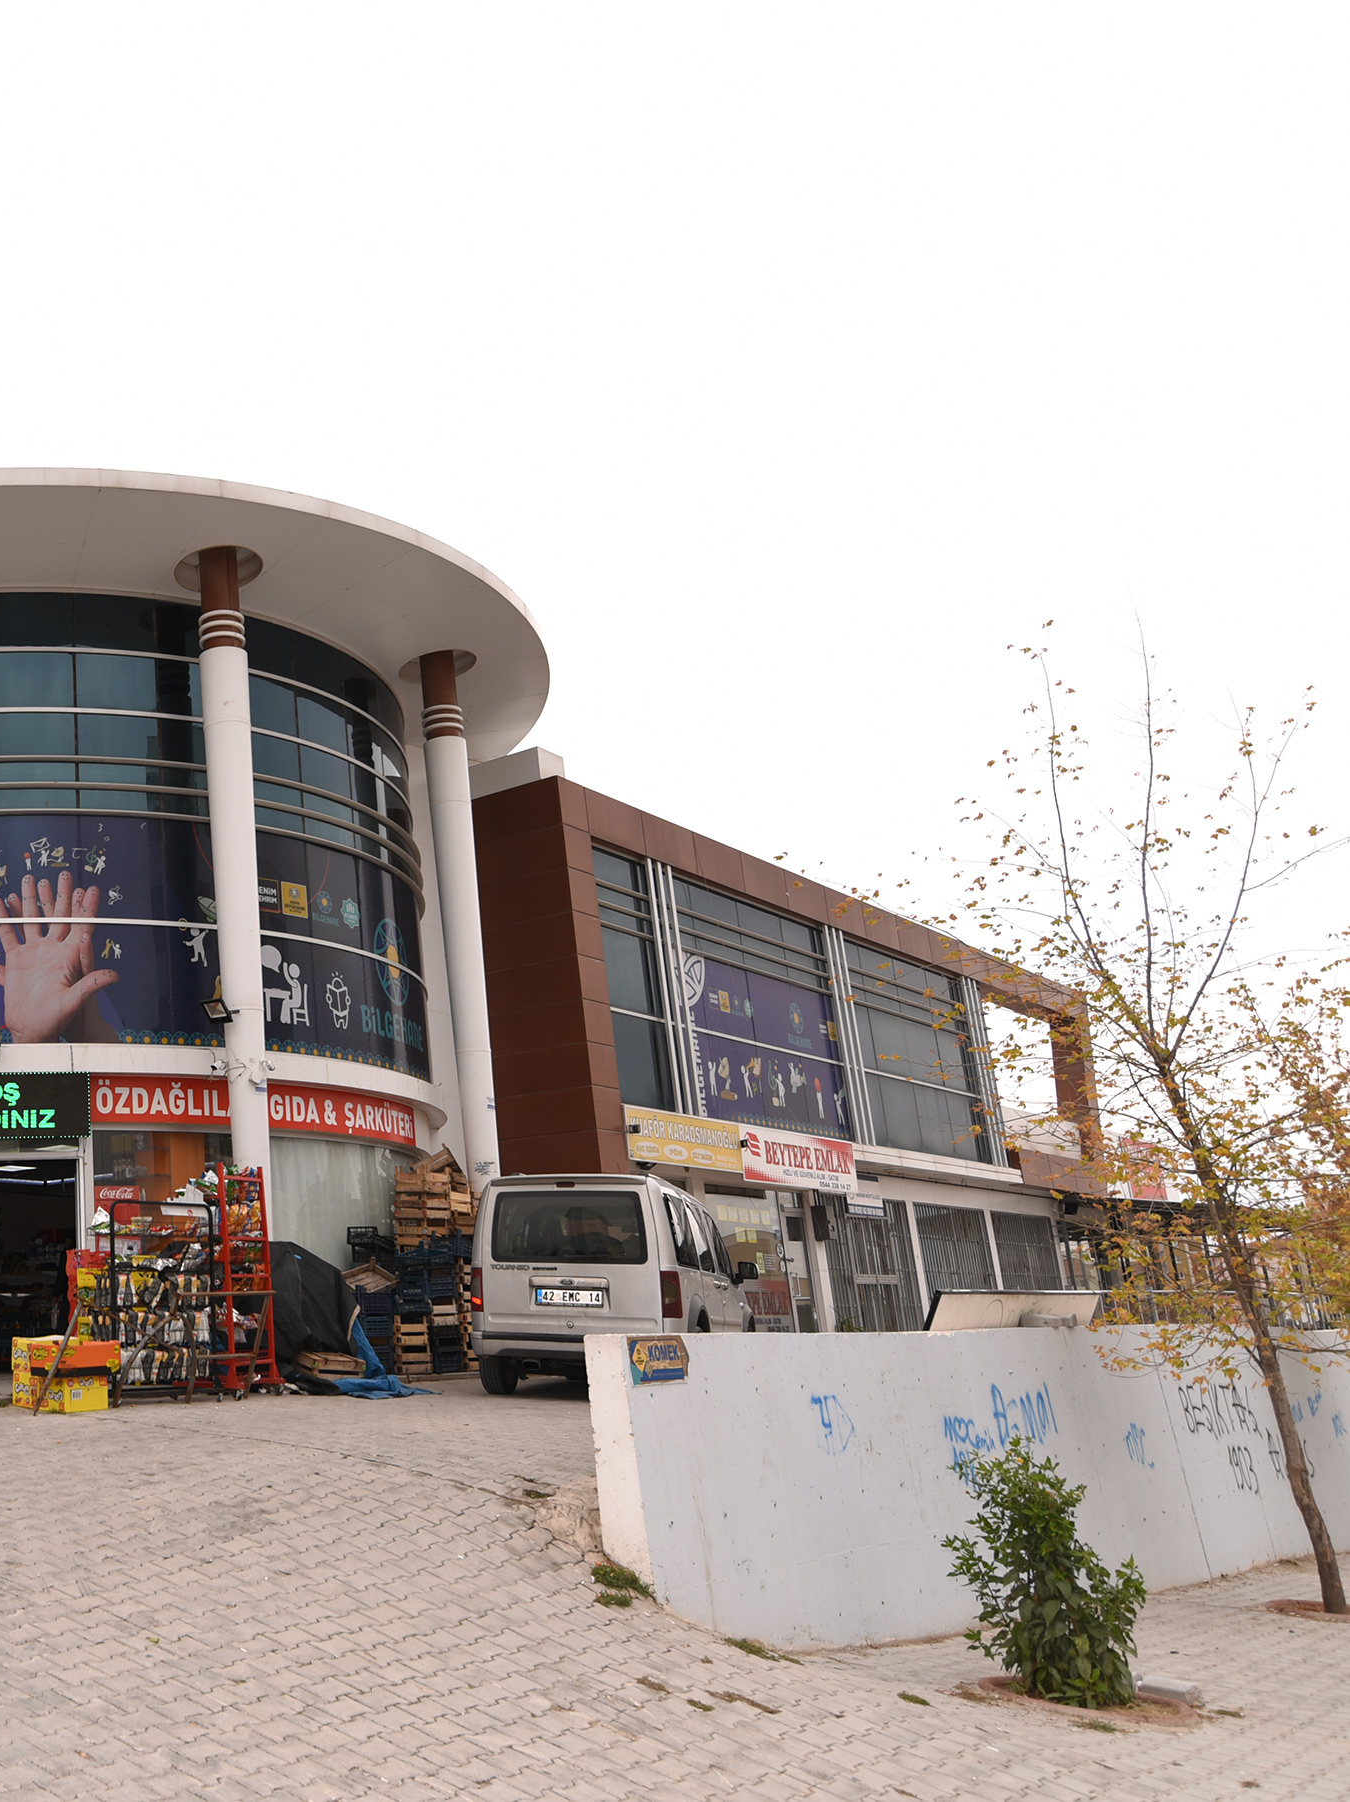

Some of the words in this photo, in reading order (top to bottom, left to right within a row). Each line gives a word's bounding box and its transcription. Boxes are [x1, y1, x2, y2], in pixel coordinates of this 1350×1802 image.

[258, 886, 277, 896] ENİM
[258, 894, 278, 904] EHRİM
[95, 1078, 231, 1117] ÖZDAĞLIL
[269, 1094, 320, 1125] GIDA
[324, 1099, 338, 1126] &
[763, 1140, 814, 1170] BEYTEPE
[814, 1148, 852, 1175] EMLAK
[99, 1187, 135, 1200] Coca-Cola
[542, 1291, 555, 1302] 42
[562, 1291, 581, 1302] EMC
[589, 1292, 601, 1303] 14
[647, 1344, 681, 1362] KOMEK
